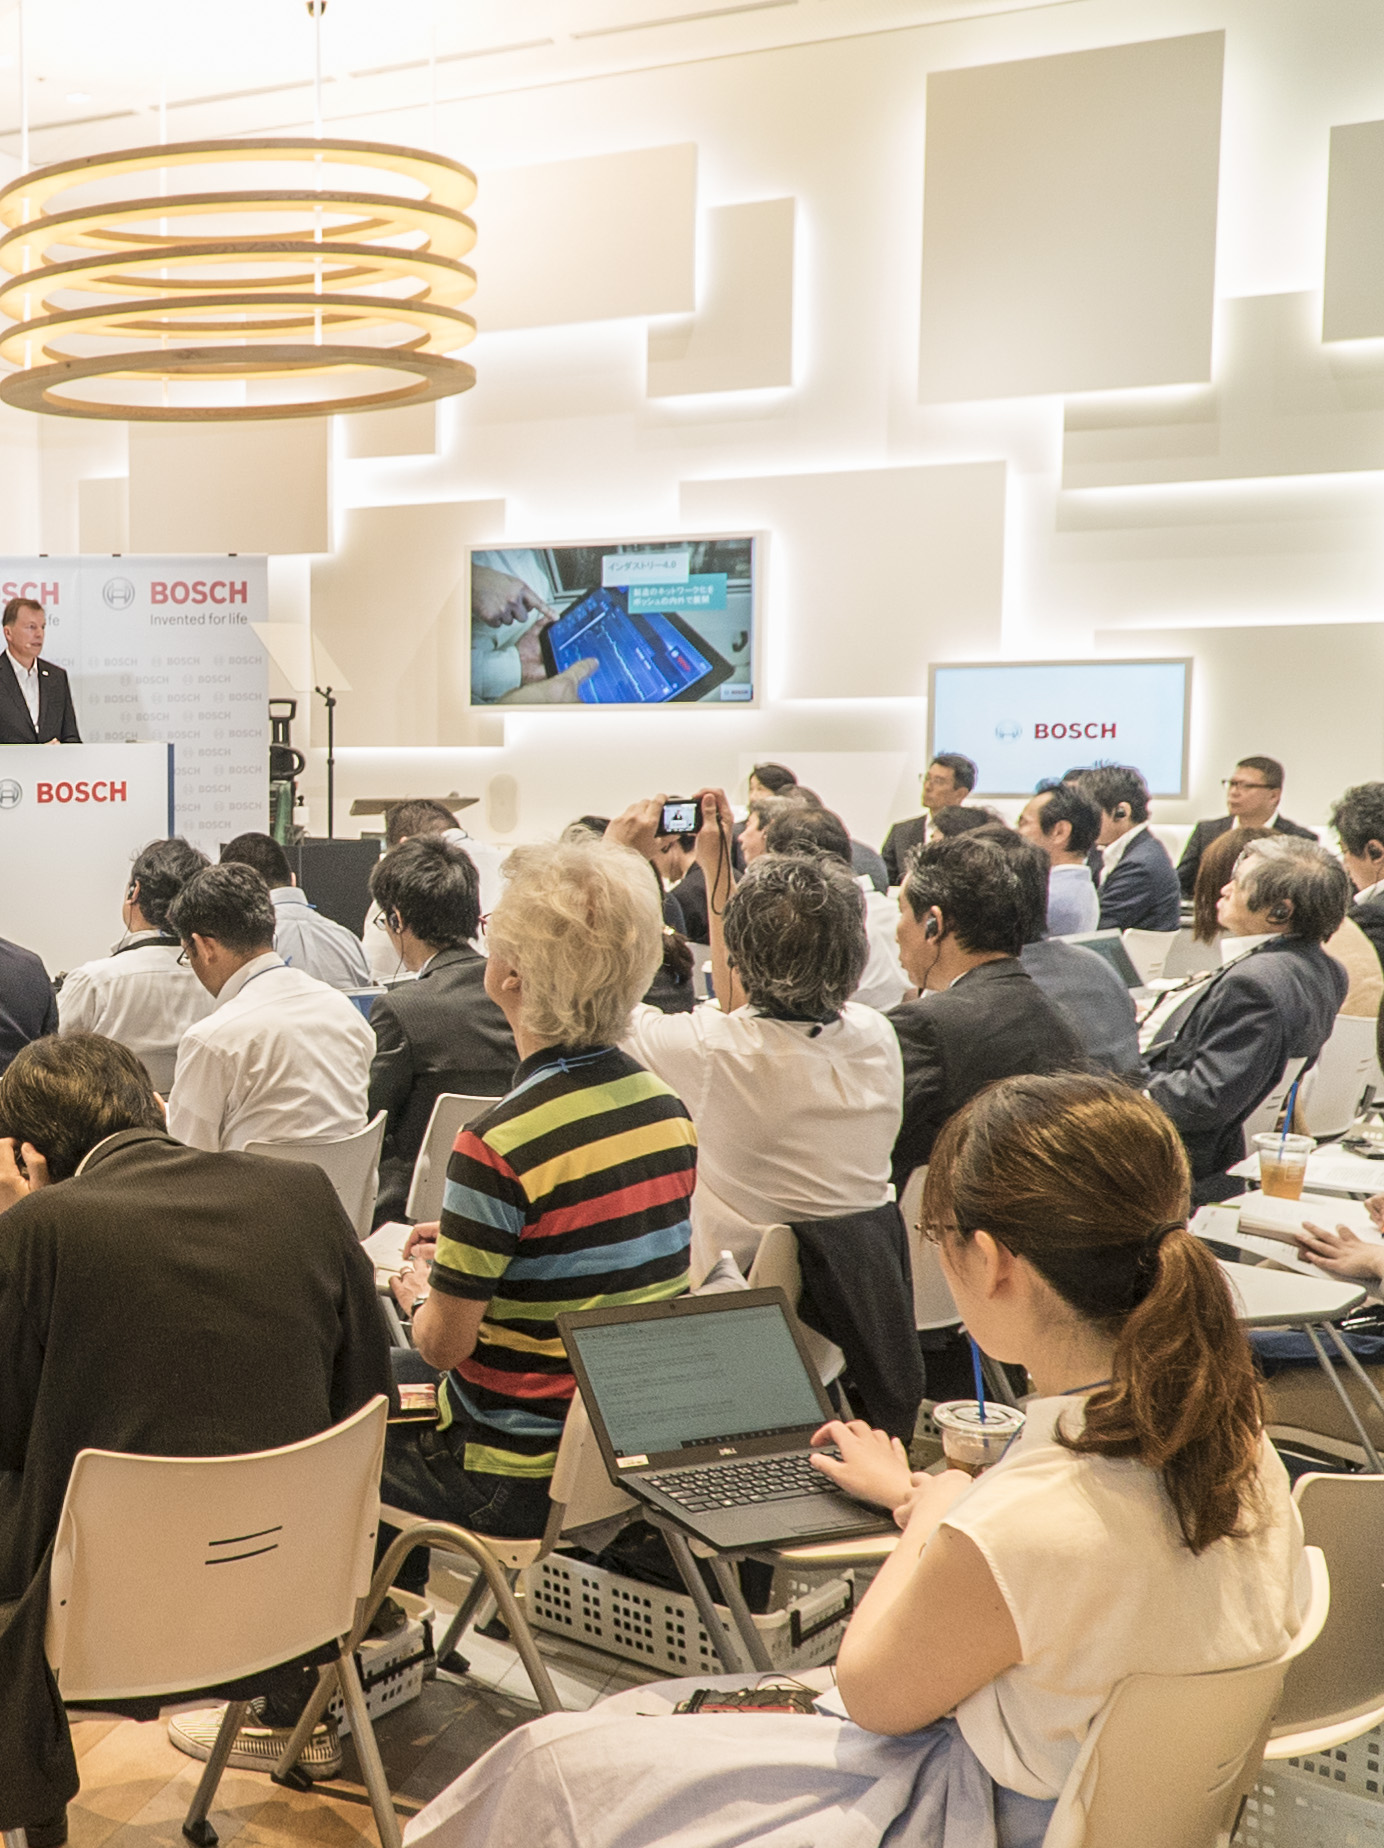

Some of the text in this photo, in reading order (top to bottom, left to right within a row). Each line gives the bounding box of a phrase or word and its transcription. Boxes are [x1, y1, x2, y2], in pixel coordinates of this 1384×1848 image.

[608, 560, 677, 571] インダストリー4.0
[151, 580, 248, 604] BOSCH
[150, 612, 248, 625] Invented for life
[104, 657, 138, 666] BOSCH
[167, 657, 200, 666] BOSCH
[229, 656, 262, 665] BOSCH
[136, 676, 169, 684] BOSCH
[198, 675, 231, 684] BOSCH
[104, 695, 138, 704] BOSCH
[167, 694, 200, 703] BOSCH
[229, 693, 262, 702] BOSCH
[136, 712, 169, 721] BOSCH
[198, 712, 231, 720] BOSCH
[167, 731, 200, 740] BOSCH
[229, 730, 262, 739] BOSCH
[1034, 722, 1117, 740] BOSCH
[105, 732, 138, 741] BOSCH
[198, 748, 231, 757] BOSCH
[175, 767, 200, 776] OSCH
[229, 766, 262, 775] BOSCH
[37, 781, 127, 803] BOSCH
[198, 785, 231, 793] BOSCH
[175, 803, 200, 812] OSCH
[229, 802, 262, 811] BOSCH
[198, 821, 231, 830] BOSCH
